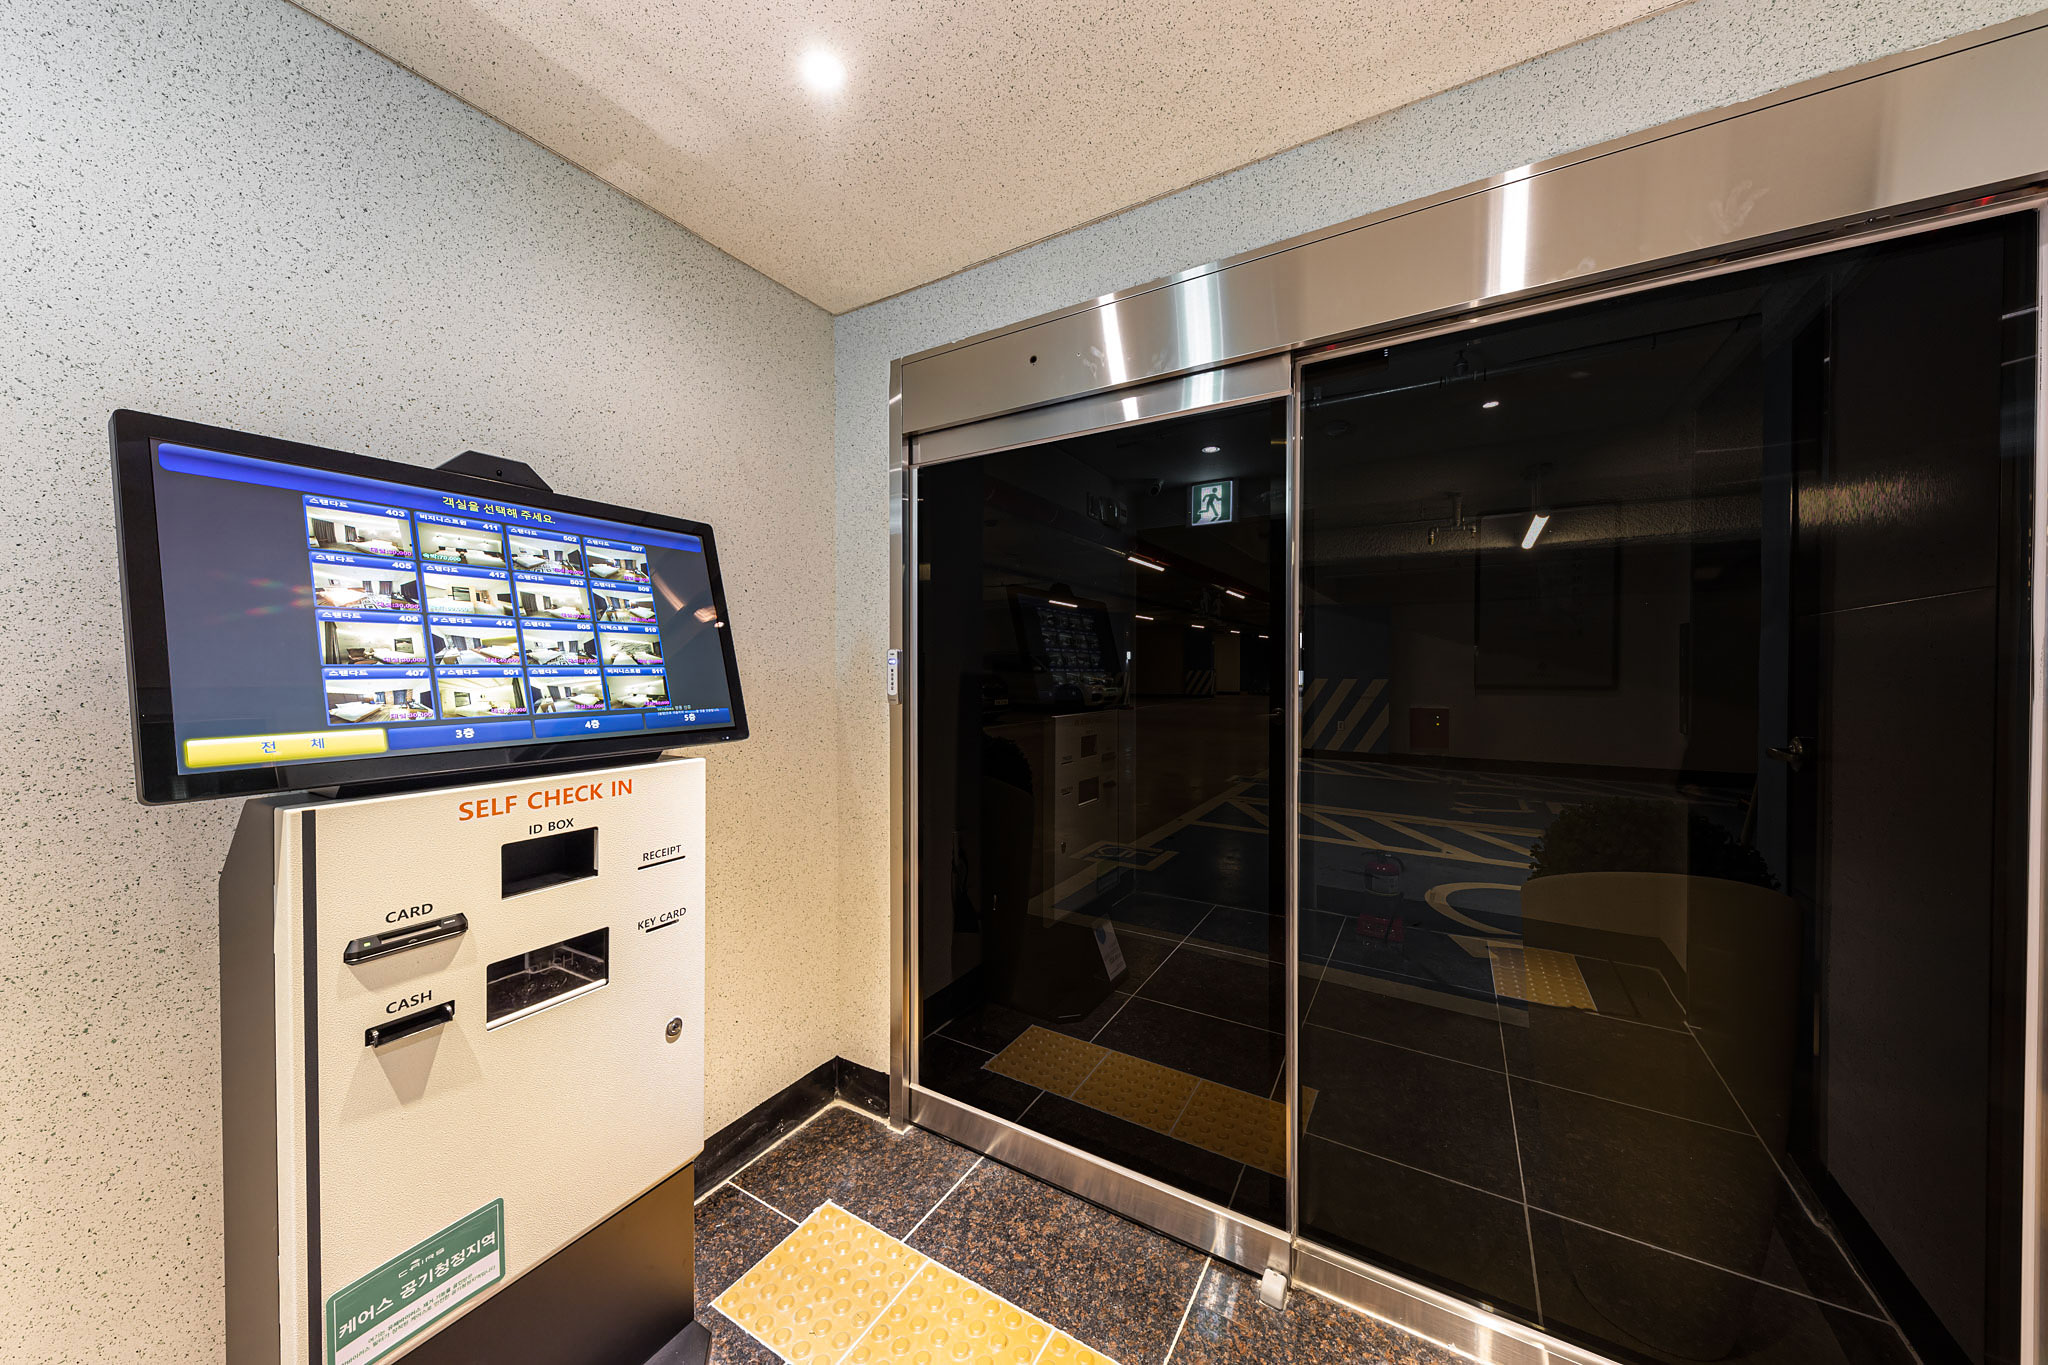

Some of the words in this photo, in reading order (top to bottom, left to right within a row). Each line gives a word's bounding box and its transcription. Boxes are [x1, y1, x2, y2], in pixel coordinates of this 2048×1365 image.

[385, 509, 405, 518] 403
[442, 496, 480, 512] 객실을
[483, 503, 518, 519] 선택해
[520, 509, 556, 524] 주세요.
[482, 523, 498, 531] 411
[392, 561, 412, 570] 405
[489, 571, 506, 579] 412
[399, 615, 419, 623] 406
[405, 669, 426, 677] 407
[585, 719, 601, 729] 4층
[684, 713, 696, 721] 5층
[455, 727, 475, 739] 3층
[261, 740, 277, 754] 전
[310, 737, 325, 749] 체
[458, 794, 518, 822] SELF
[527, 782, 604, 810] CHECK
[611, 778, 633, 797] IN
[528, 824, 543, 835] ID
[548, 817, 574, 832] BOX
[642, 844, 682, 862] RECEIPT
[385, 903, 434, 924] CARD
[637, 916, 657, 931] KEY
[659, 907, 687, 923] CARD
[385, 989, 432, 1014] CASH
[338, 1297, 394, 1339] 케어스
[400, 1231, 497, 1300] 공기청정지역
